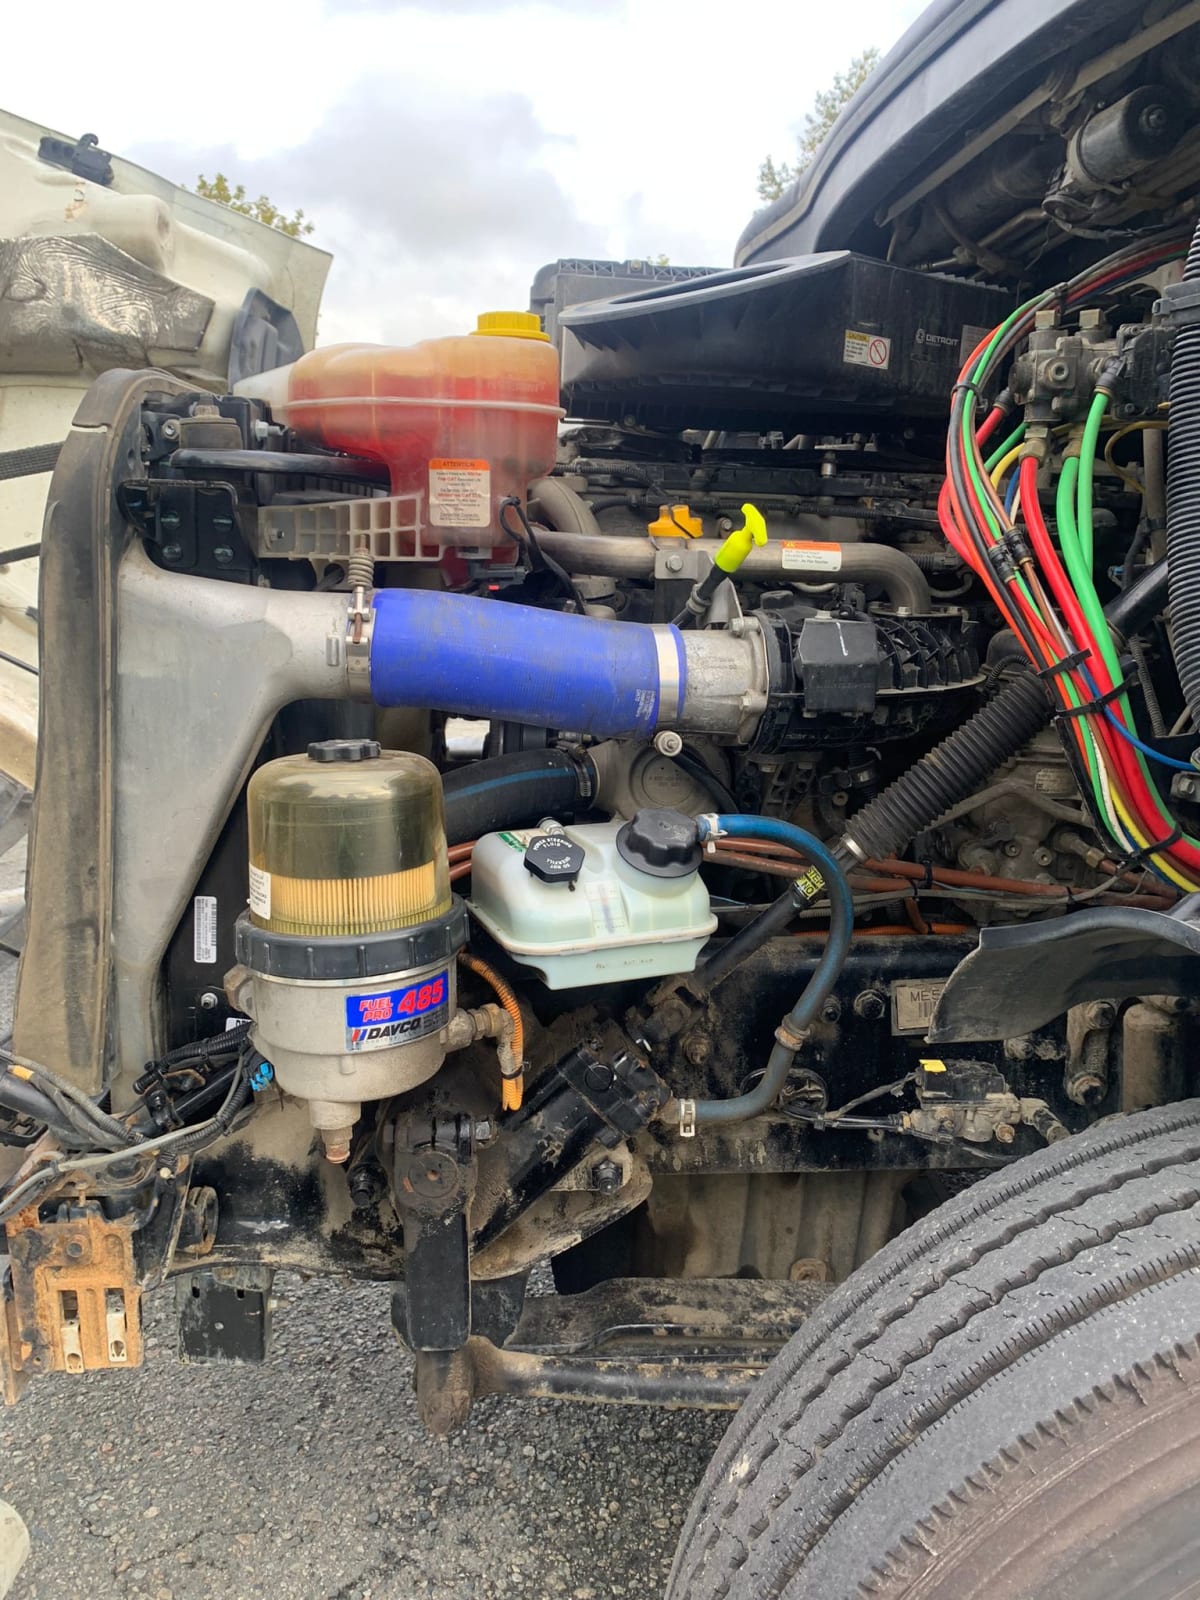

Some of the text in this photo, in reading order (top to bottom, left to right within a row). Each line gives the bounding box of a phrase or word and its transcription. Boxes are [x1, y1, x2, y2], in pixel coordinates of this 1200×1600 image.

[925, 333, 959, 347] DETROIT
[533, 838, 546, 851] POWER
[547, 838, 573, 849] STEERING
[359, 978, 444, 1014] FUEL 485
[363, 1007, 392, 1022] PRO
[367, 1017, 421, 1040] DAVCO
